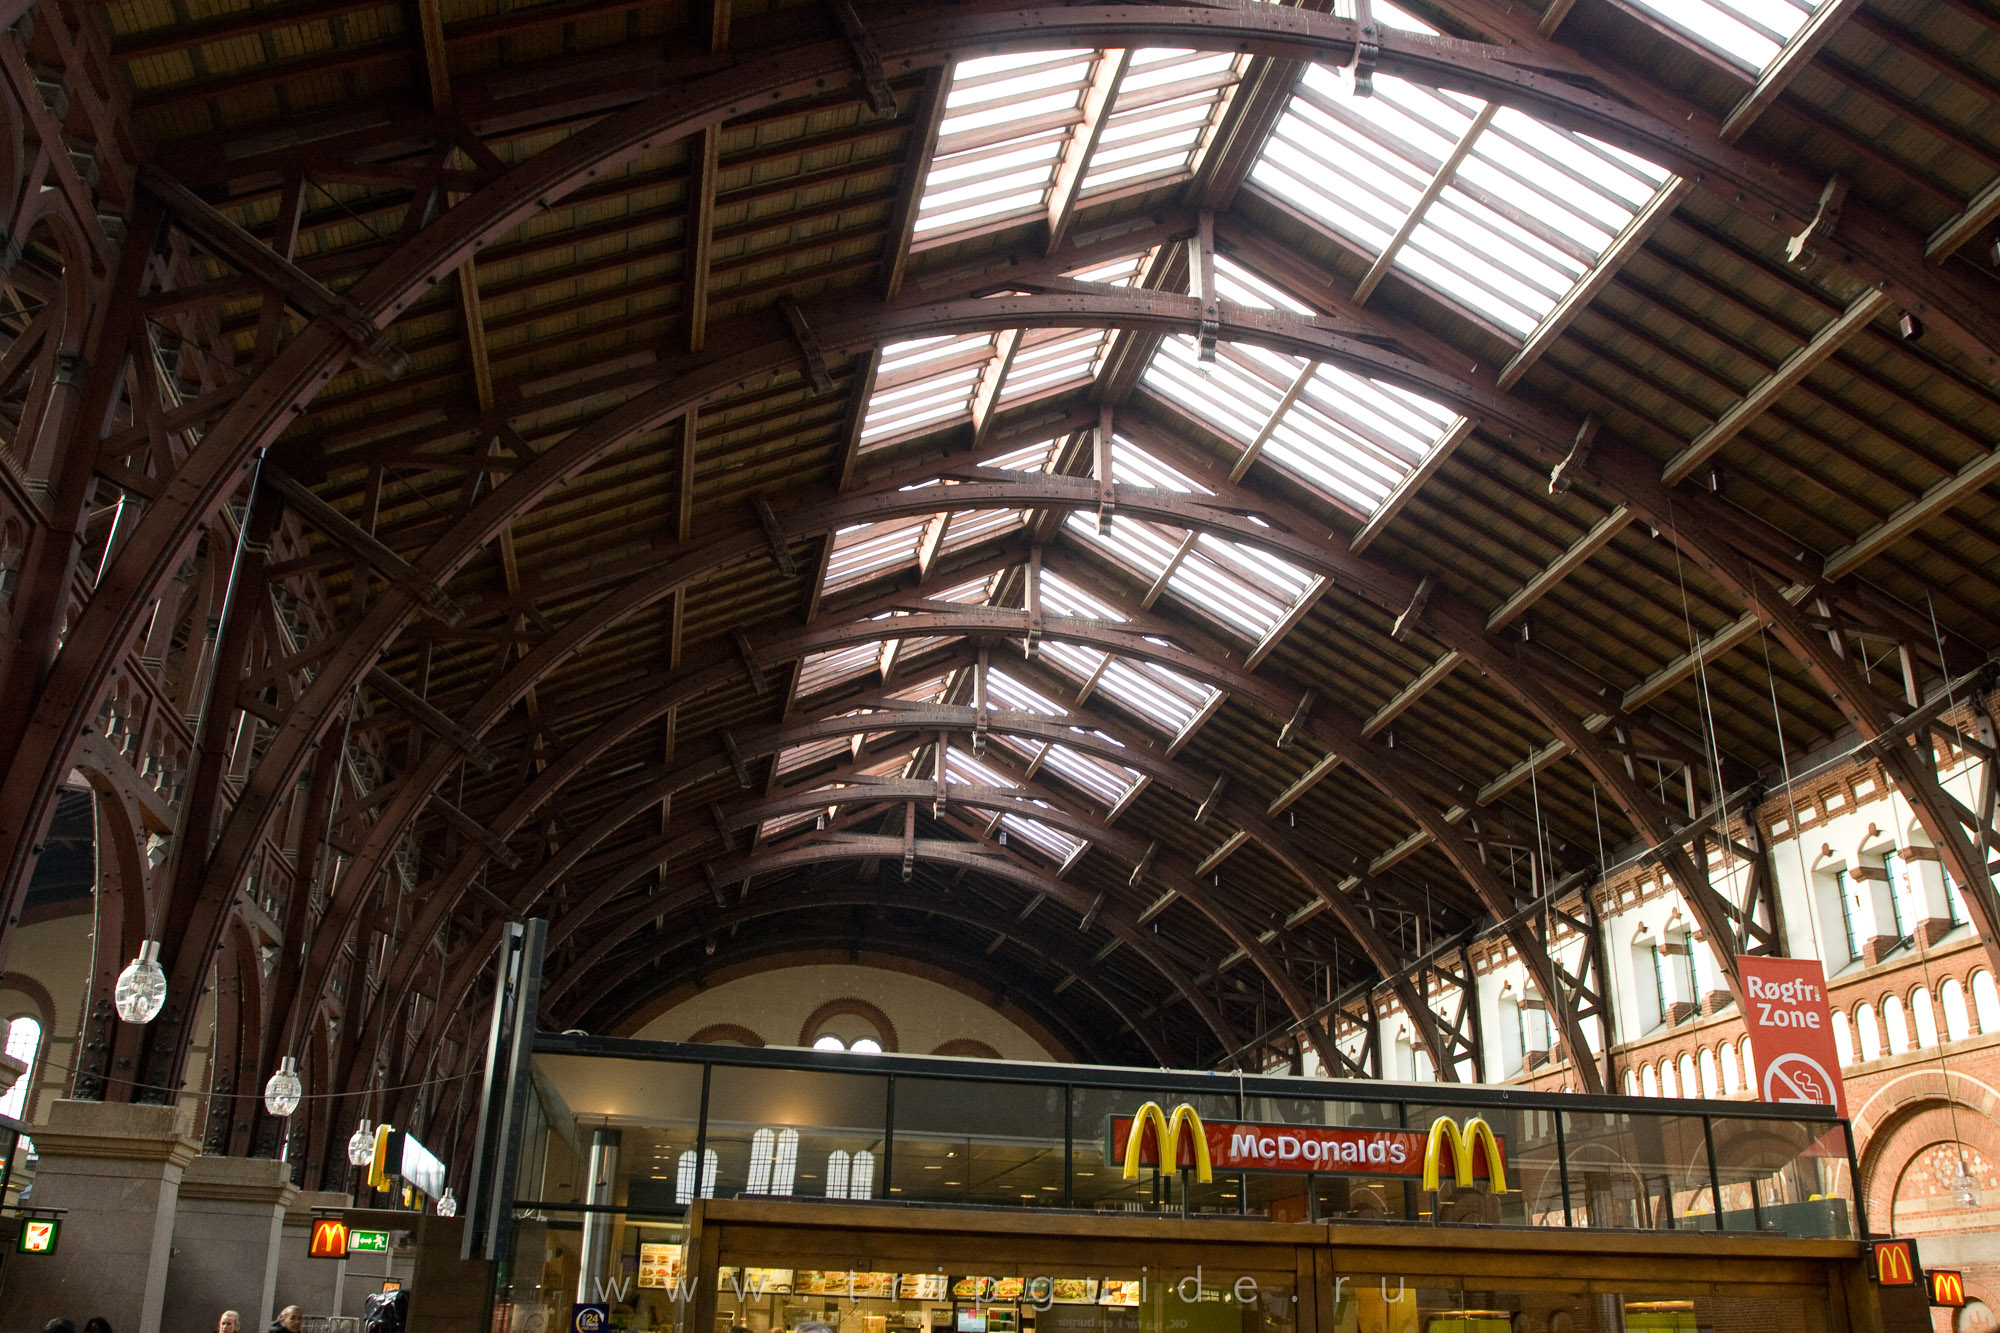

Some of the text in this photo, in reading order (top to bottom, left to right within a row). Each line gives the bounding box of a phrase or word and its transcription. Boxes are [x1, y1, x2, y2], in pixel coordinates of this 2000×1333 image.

[1756, 1003, 1821, 1029] Zone
[1230, 1134, 1406, 1164] McDonald's
[586, 1313, 598, 1322] 24
